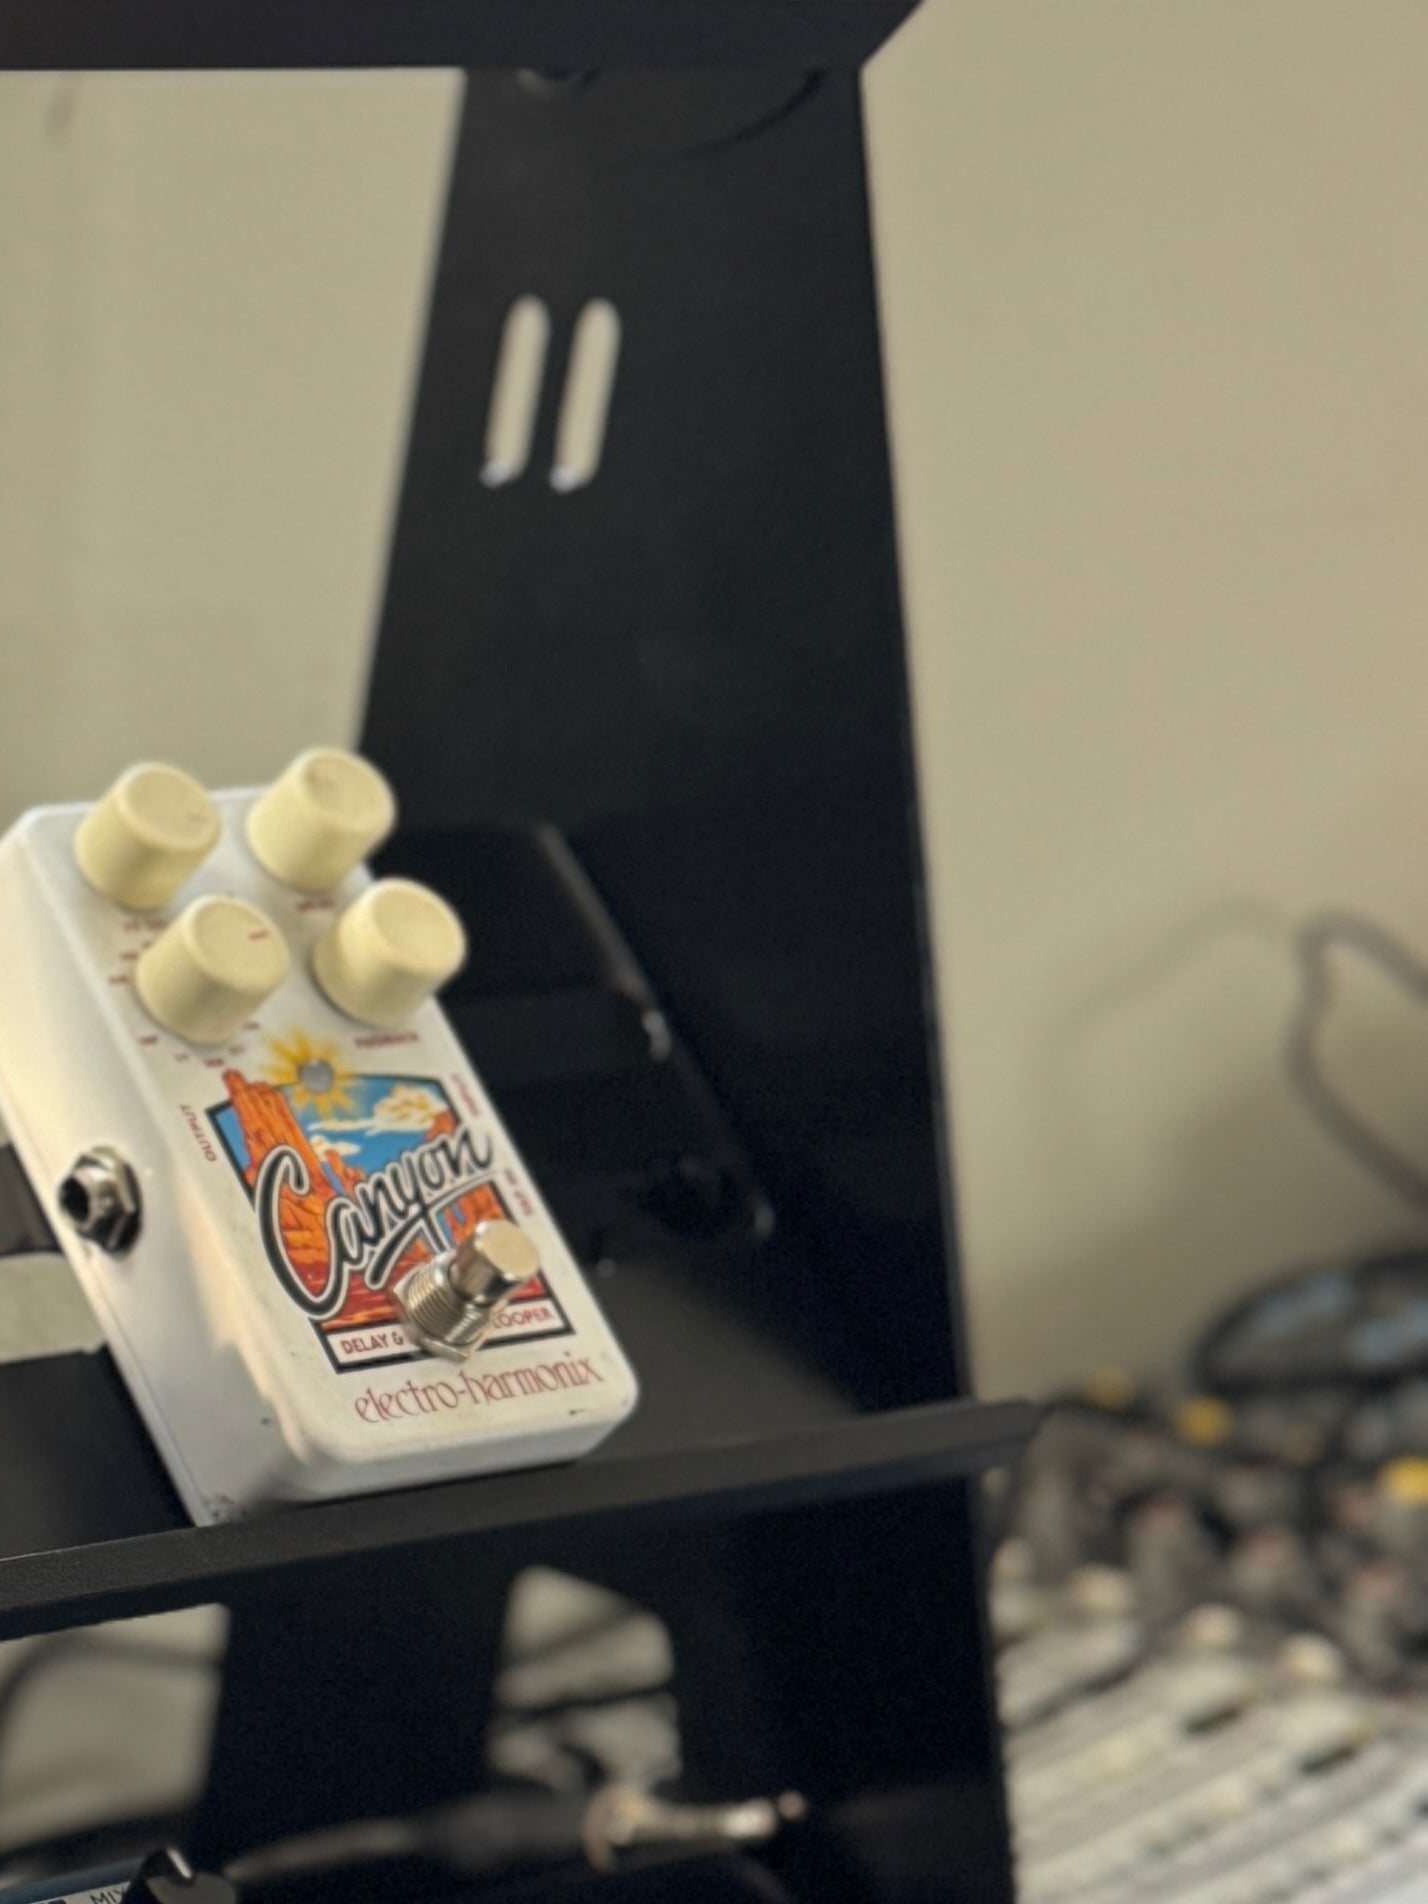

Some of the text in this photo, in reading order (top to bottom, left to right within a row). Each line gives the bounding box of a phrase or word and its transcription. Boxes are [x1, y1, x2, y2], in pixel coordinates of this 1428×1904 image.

[256, 1127, 494, 1320] Canyon
[341, 1307, 554, 1355] DELAY LOOPER
[354, 1353, 605, 1424] electro-harmonix
